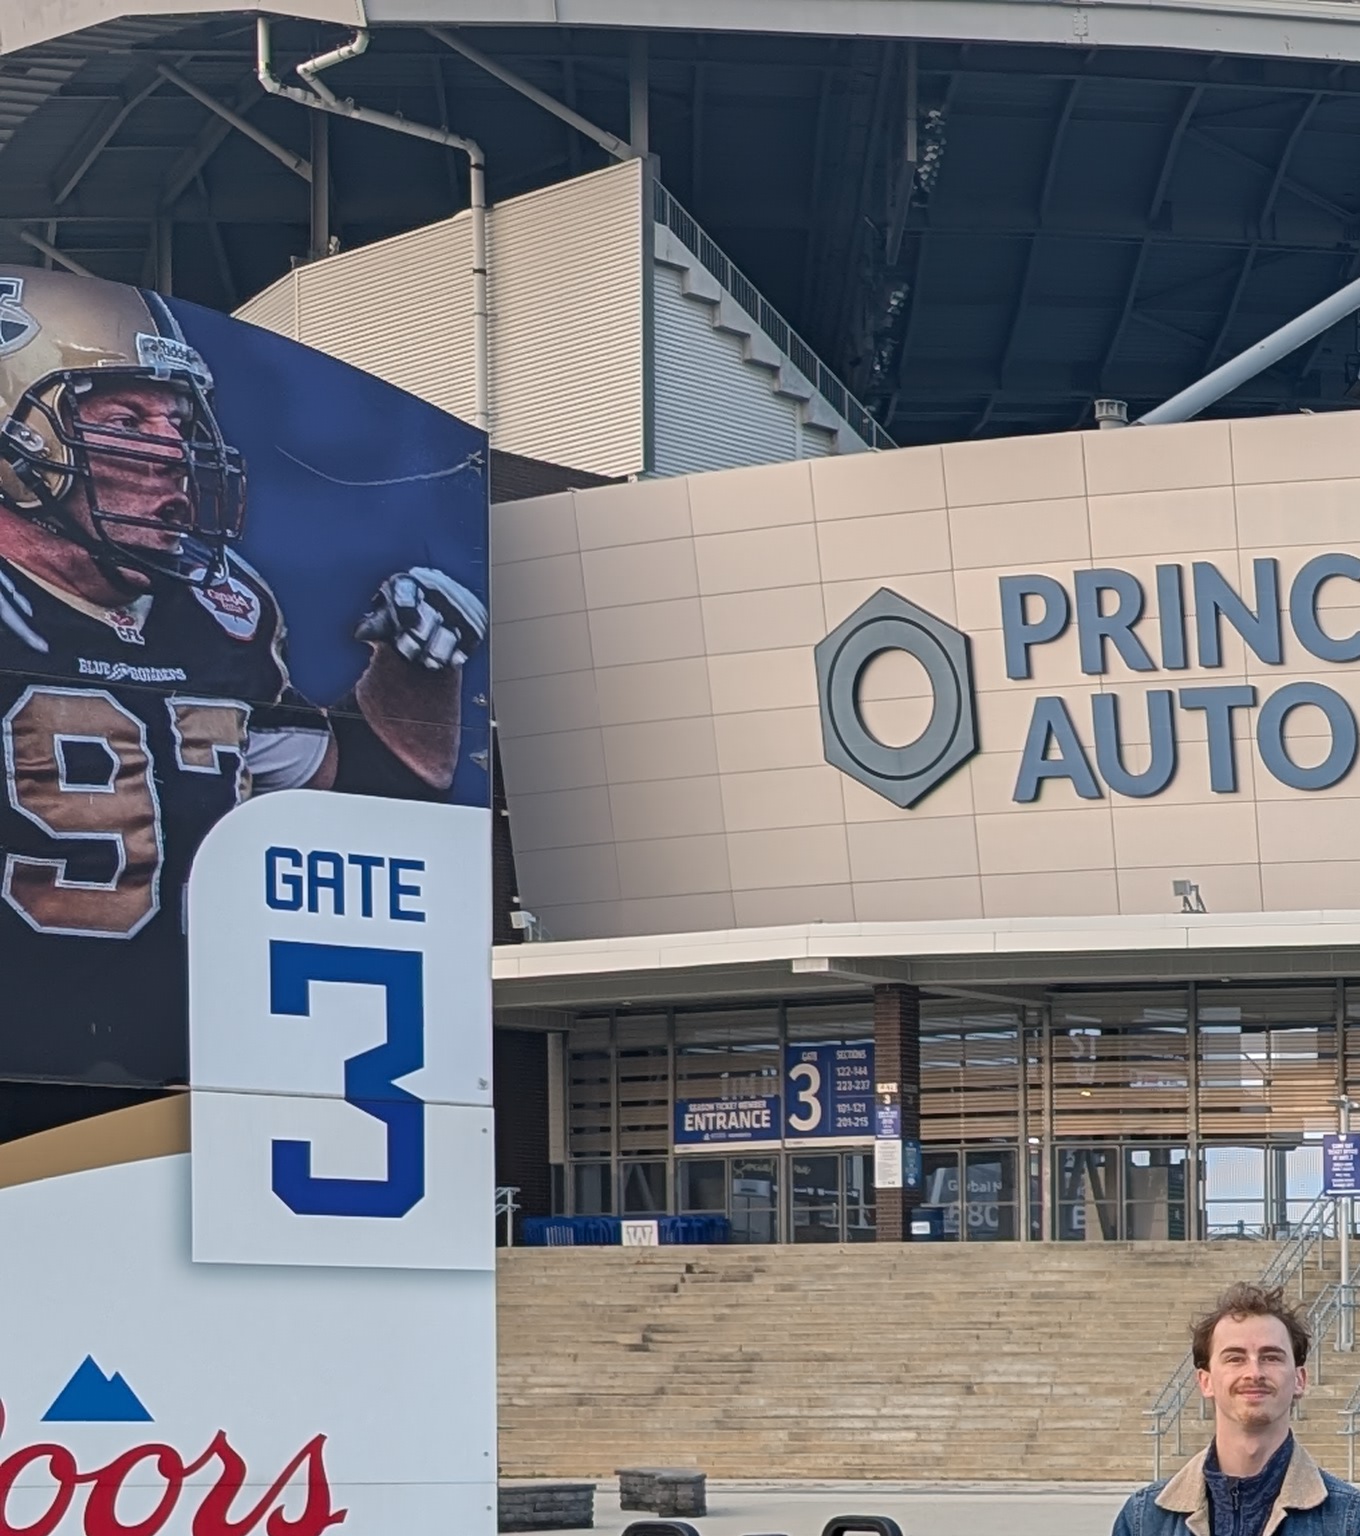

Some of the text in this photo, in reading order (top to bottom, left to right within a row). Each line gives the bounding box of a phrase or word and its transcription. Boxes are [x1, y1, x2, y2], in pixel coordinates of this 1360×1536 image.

[78, 657, 187, 682] BLUE BOMBERS
[1012, 681, 1359, 802] AUTO
[265, 846, 426, 922] GATE
[269, 939, 425, 1218] 3
[789, 1063, 822, 1131] 3
[684, 1109, 771, 1132] ENTRANCE
